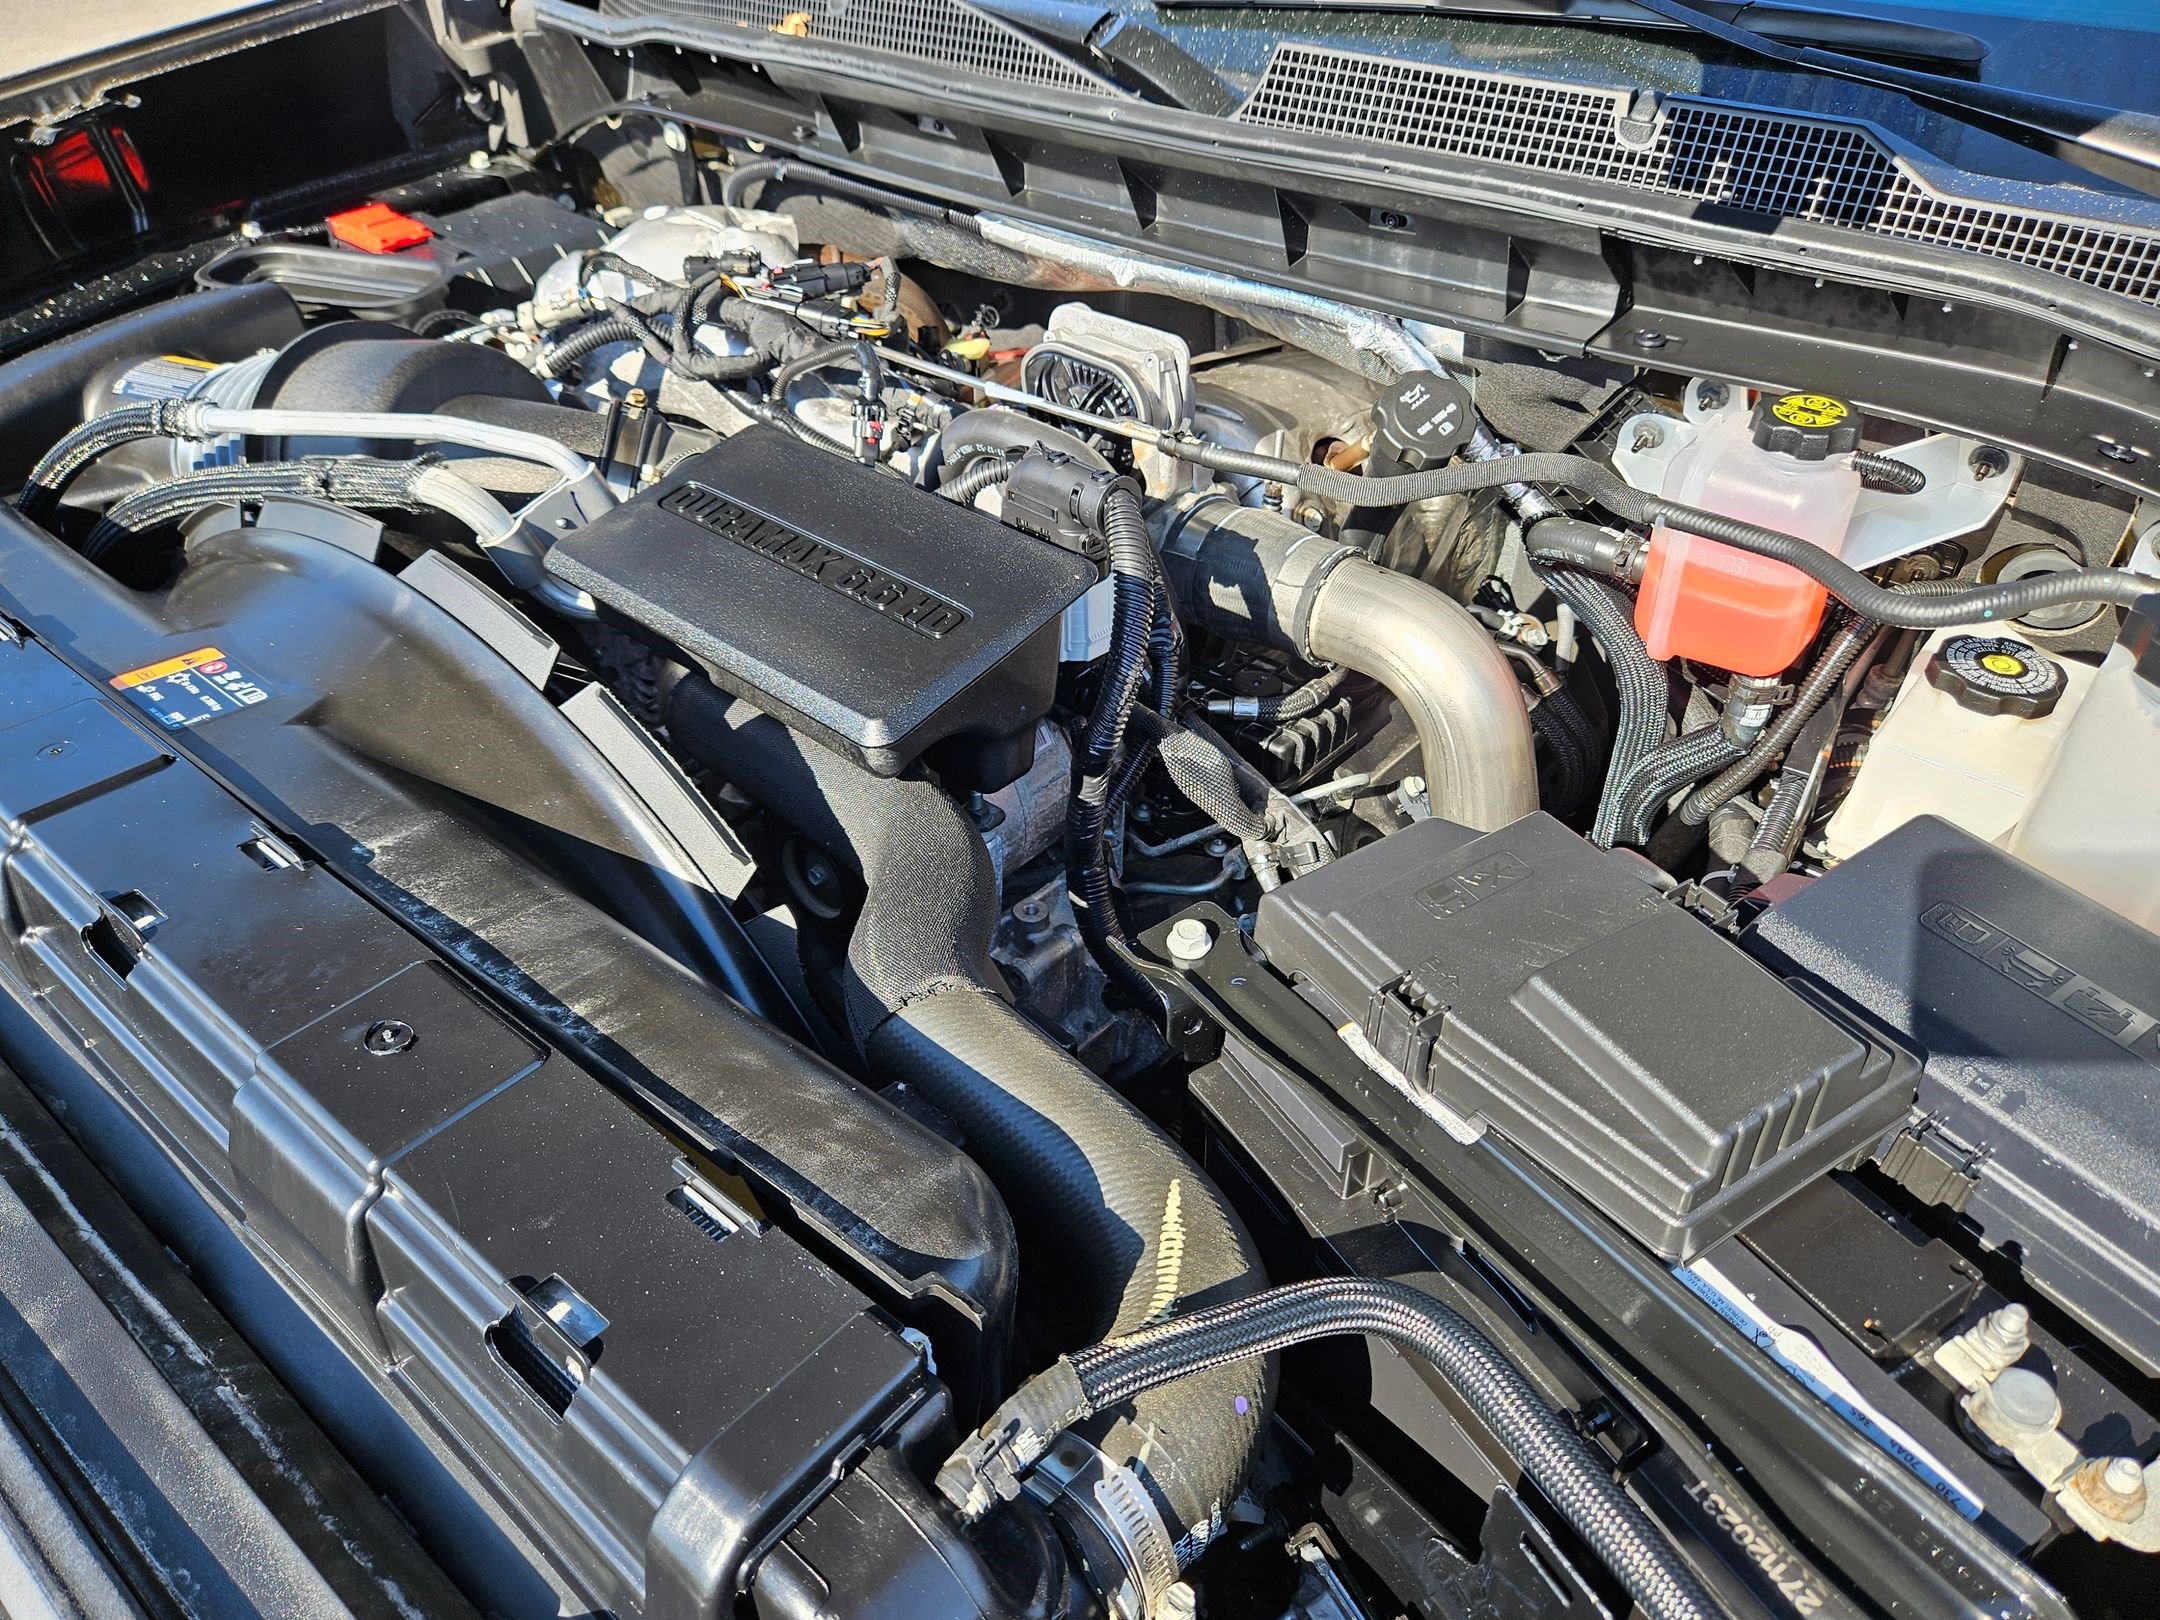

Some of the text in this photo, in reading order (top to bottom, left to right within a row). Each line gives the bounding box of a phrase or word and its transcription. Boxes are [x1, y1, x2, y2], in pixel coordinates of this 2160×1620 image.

[672, 487, 965, 639] DURAMAX 6.6 HD
[1849, 1406, 1960, 1506] 730 70Ah 365
[1682, 1482, 1822, 1616] 27112023T
